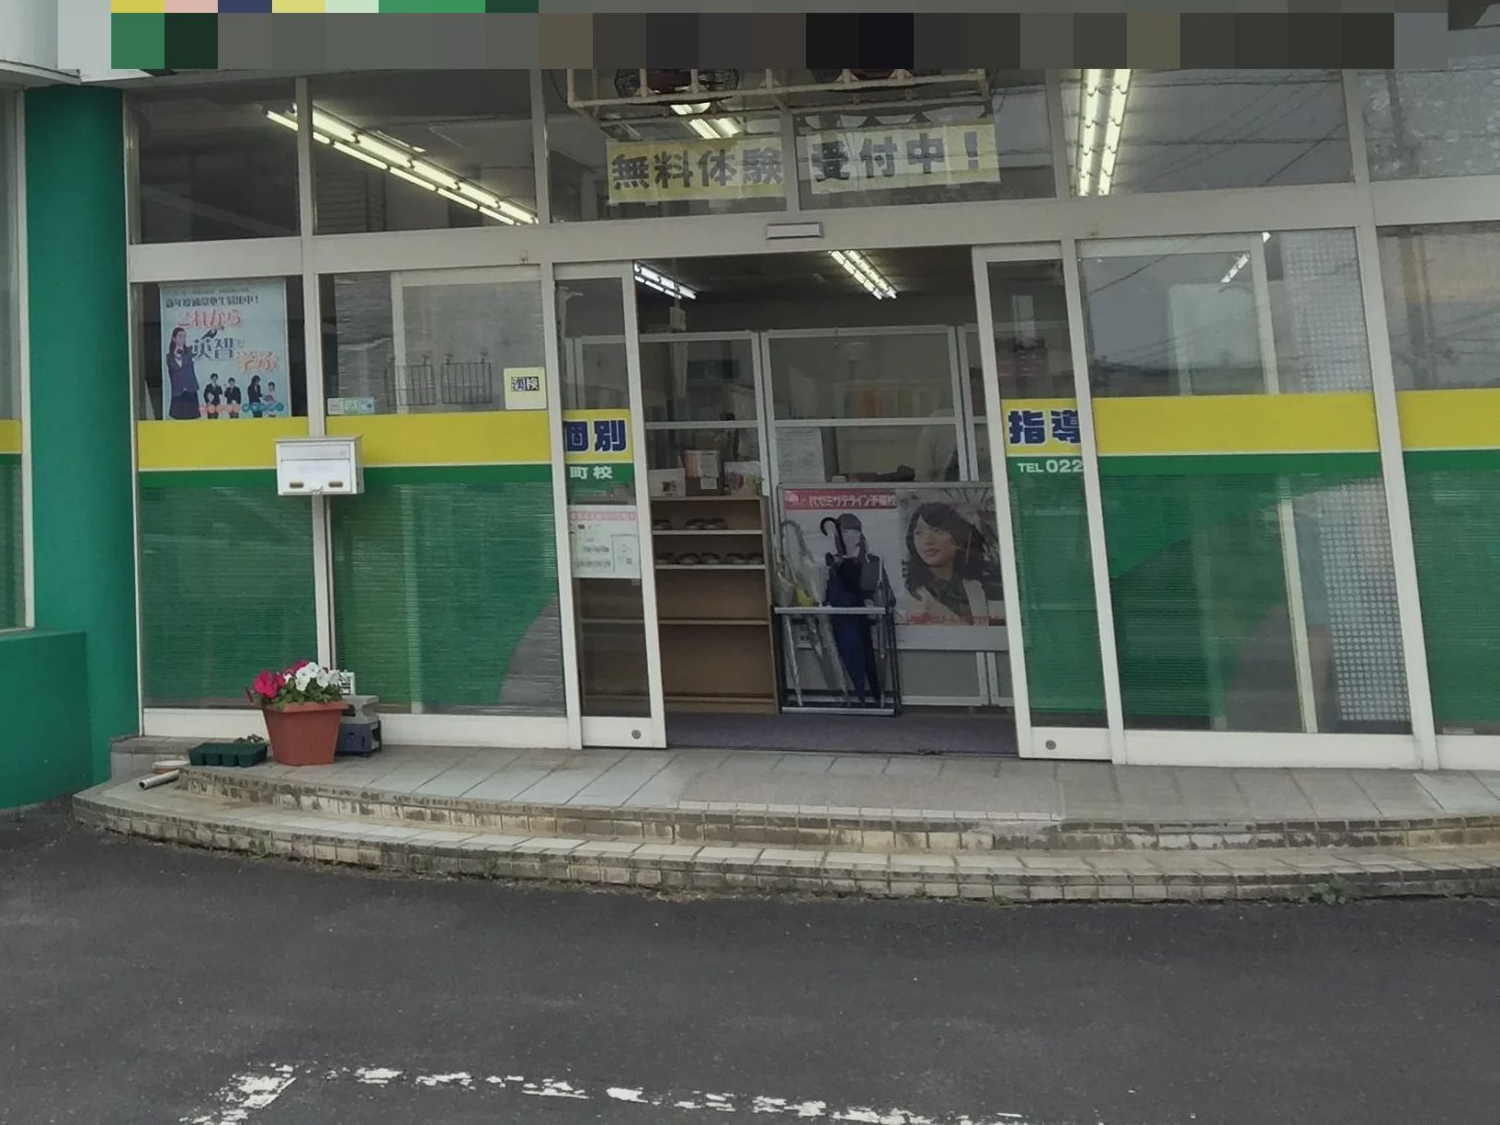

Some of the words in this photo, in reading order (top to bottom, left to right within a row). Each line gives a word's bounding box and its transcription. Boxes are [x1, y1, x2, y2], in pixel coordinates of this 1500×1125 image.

[612, 147, 783, 191] 無料体験
[1008, 409, 1081, 444] 指導
[1017, 462, 1044, 473] TEL
[1045, 459, 1084, 473] 022
